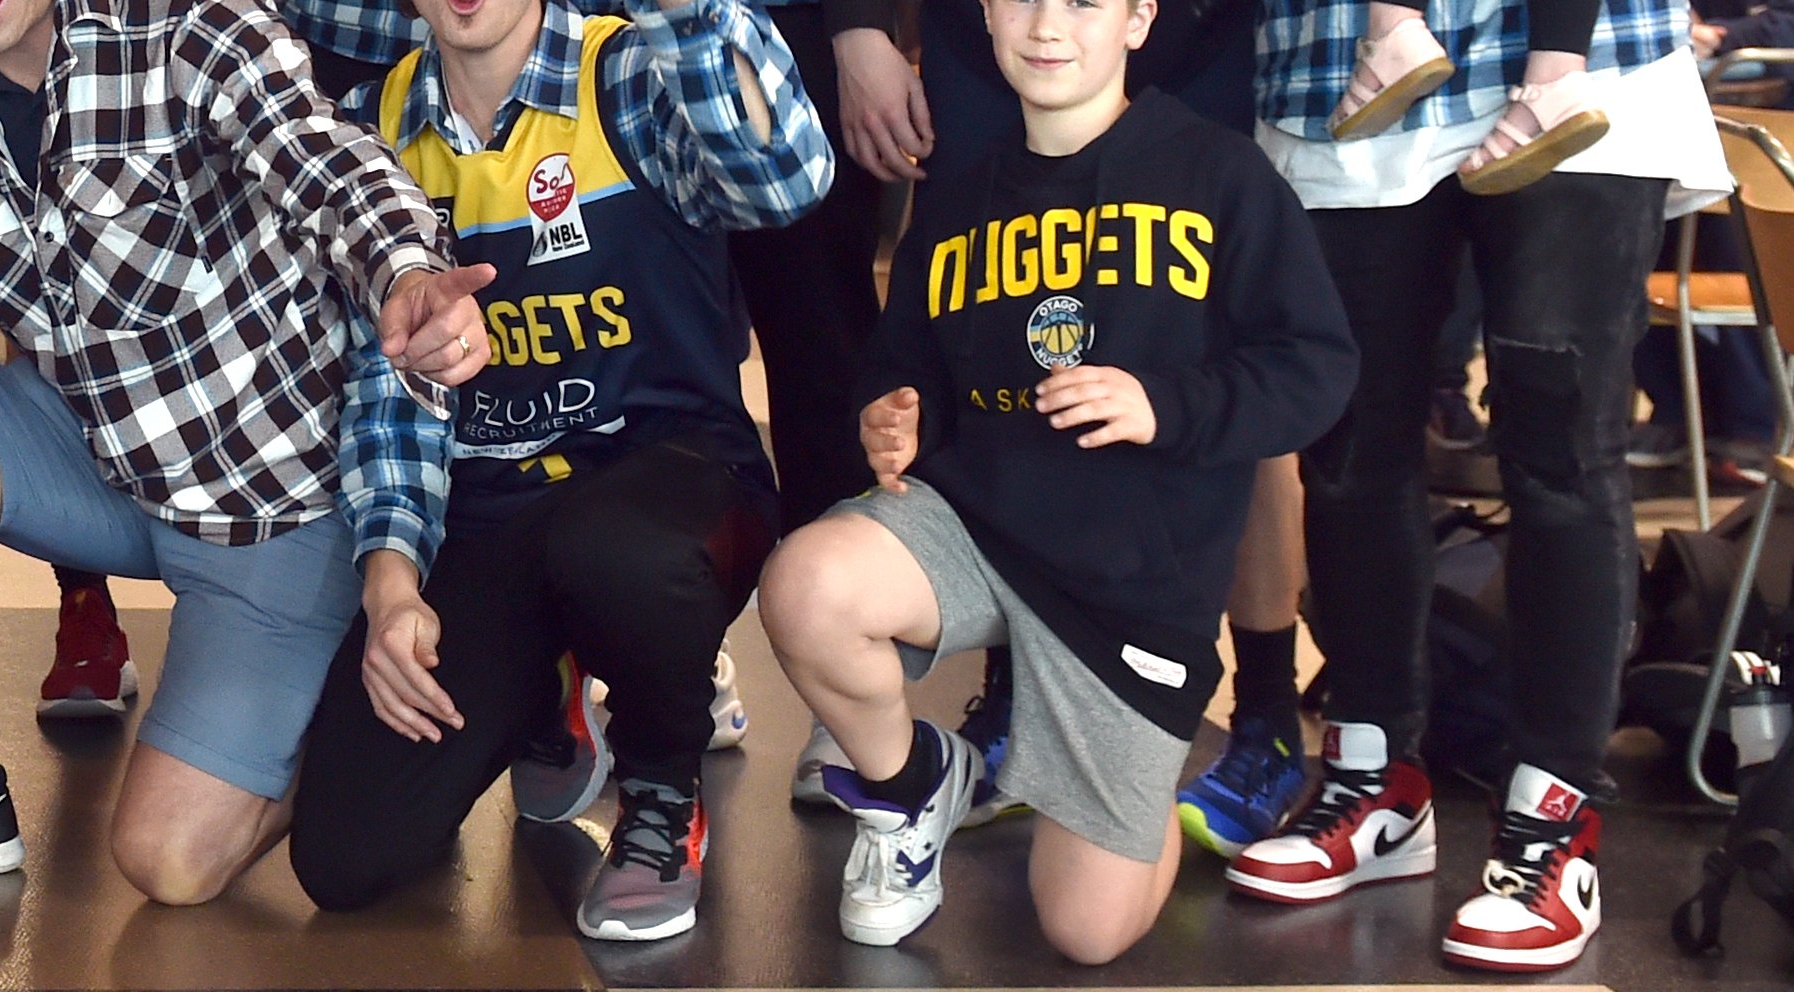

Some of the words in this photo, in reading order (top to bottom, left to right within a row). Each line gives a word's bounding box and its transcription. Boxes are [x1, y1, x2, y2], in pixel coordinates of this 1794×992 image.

[549, 222, 583, 246] NBL
[1039, 299, 1079, 317] OTAGO
[471, 378, 596, 427] FLUID
[463, 406, 599, 440] RECRUITMENT
